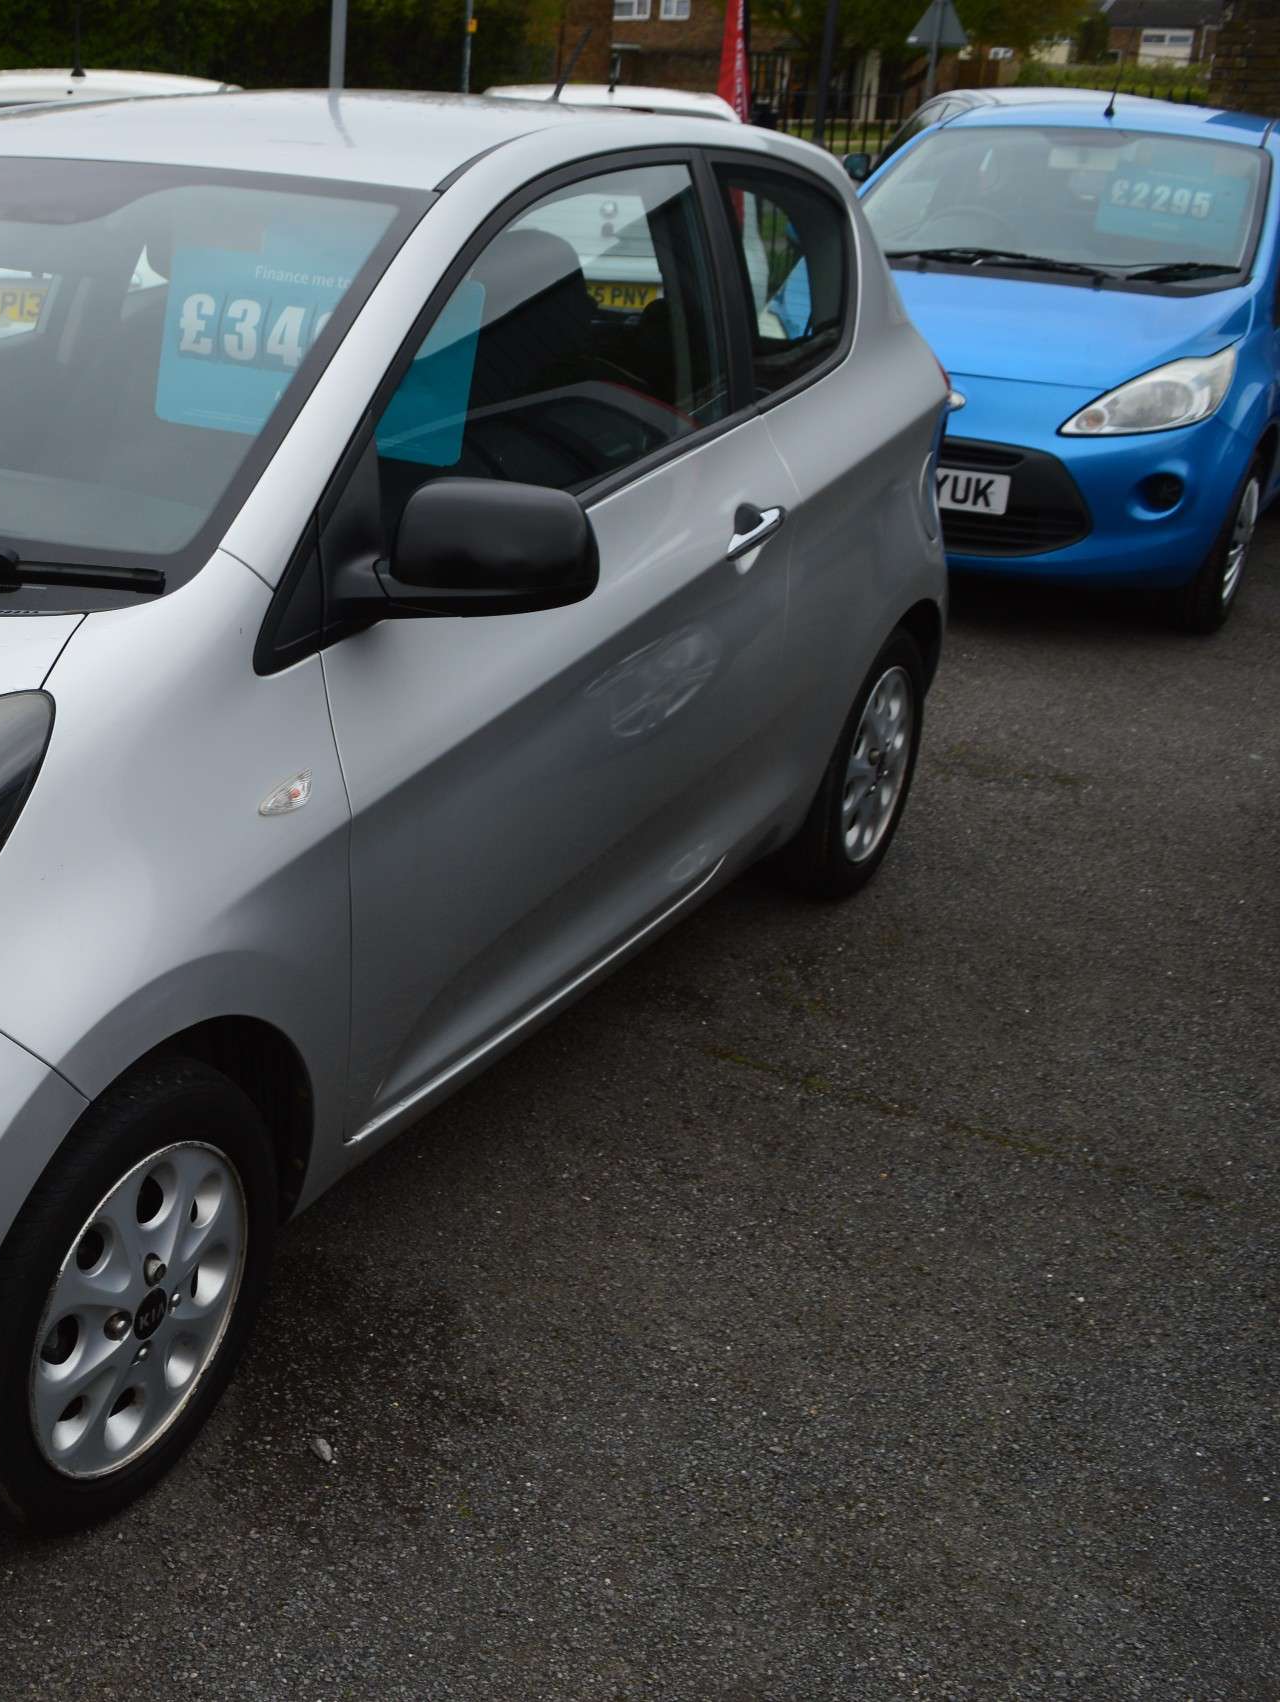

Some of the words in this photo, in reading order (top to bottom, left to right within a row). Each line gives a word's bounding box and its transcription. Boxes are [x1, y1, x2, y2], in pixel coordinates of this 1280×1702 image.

[1111, 178, 1212, 219] £2295
[254, 264, 309, 285] Finance
[312, 273, 337, 288] me
[140, 1300, 166, 1331] KIA
